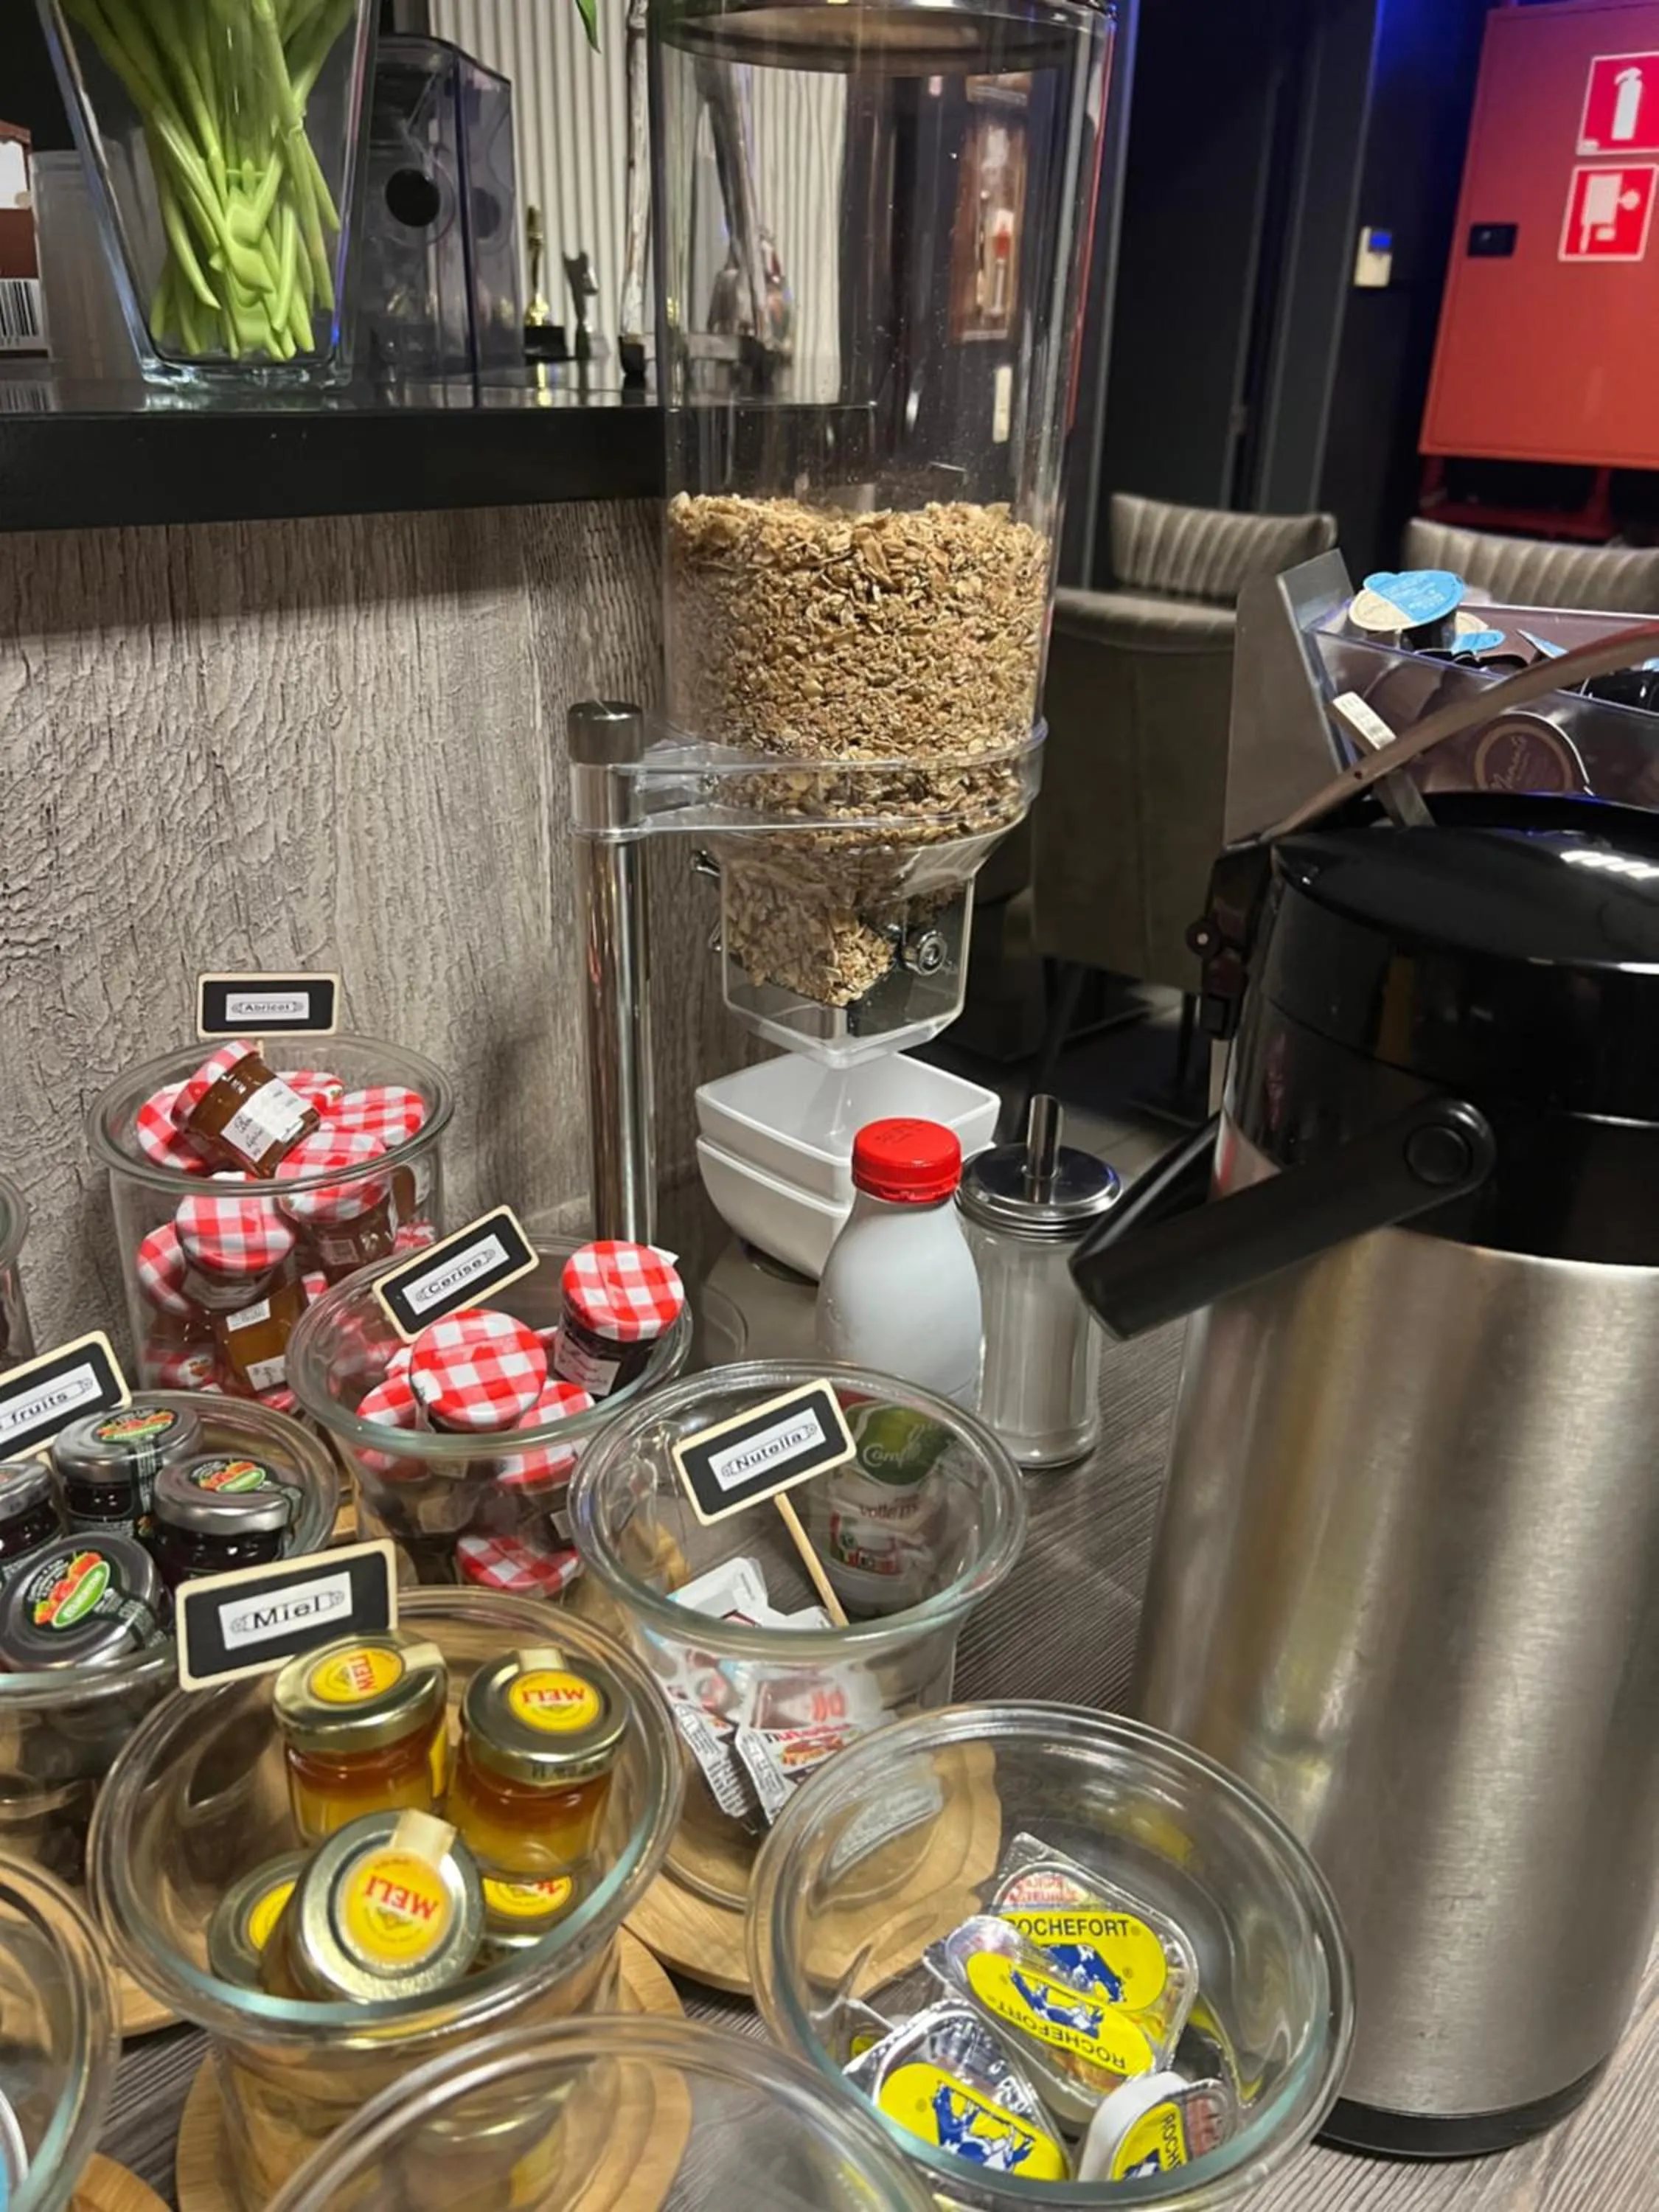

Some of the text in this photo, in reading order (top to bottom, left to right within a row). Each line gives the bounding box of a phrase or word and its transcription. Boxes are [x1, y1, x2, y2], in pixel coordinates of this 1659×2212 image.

[246, 1003, 290, 1012] Abricot
[428, 1258, 482, 1293] Cerise
[12, 1392, 67, 1425] fruits
[737, 1433, 803, 1470] Nutella
[253, 1595, 320, 1629] Miel
[349, 1654, 378, 1691] MELI
[522, 1687, 585, 1704] MELI
[366, 1874, 439, 1921] MELI
[997, 2000, 1126, 2069] ROCHEFORT
[1163, 2112, 1181, 2169] ROCH
